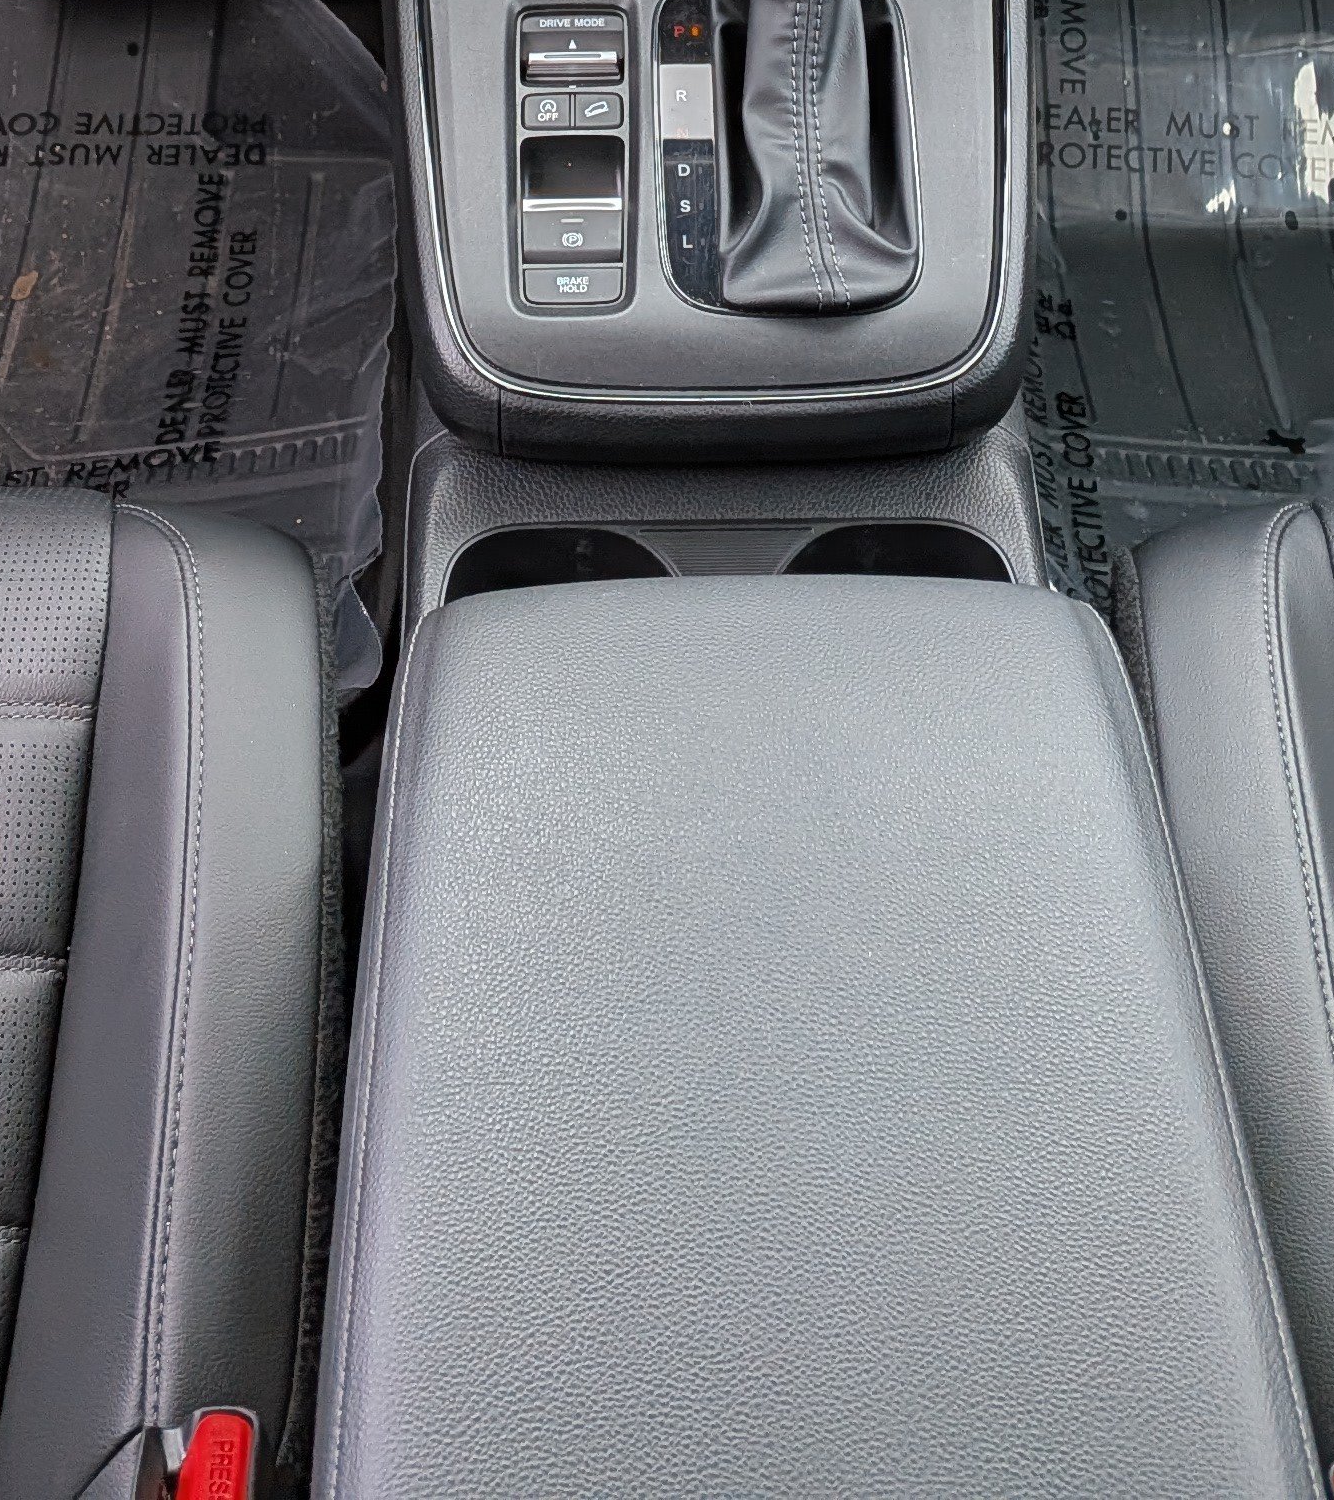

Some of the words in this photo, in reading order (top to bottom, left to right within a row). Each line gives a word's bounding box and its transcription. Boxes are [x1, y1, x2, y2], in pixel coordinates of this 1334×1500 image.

[539, 18, 571, 28] DRIVE
[574, 17, 605, 27] MODE
[673, 25, 685, 37] P
[675, 89, 687, 102] R
[74, 110, 271, 137] PROTECTIVE
[537, 112, 559, 122] OFF
[1037, 102, 1139, 135] EALER
[1166, 110, 1260, 142] MUST
[27, 142, 123, 168] MUST
[147, 142, 267, 167] DEALER
[1037, 141, 1217, 177] ROTECTIVE
[678, 164, 691, 177] D
[680, 199, 691, 213] S
[188, 171, 226, 282] REMOVE
[682, 235, 694, 248] L
[226, 228, 259, 310] COVER
[556, 276, 590, 285] BRAKE
[558, 284, 588, 293] HOLD
[1053, 390, 1095, 469] COVER
[208, 1439, 235, 1500] PRES
